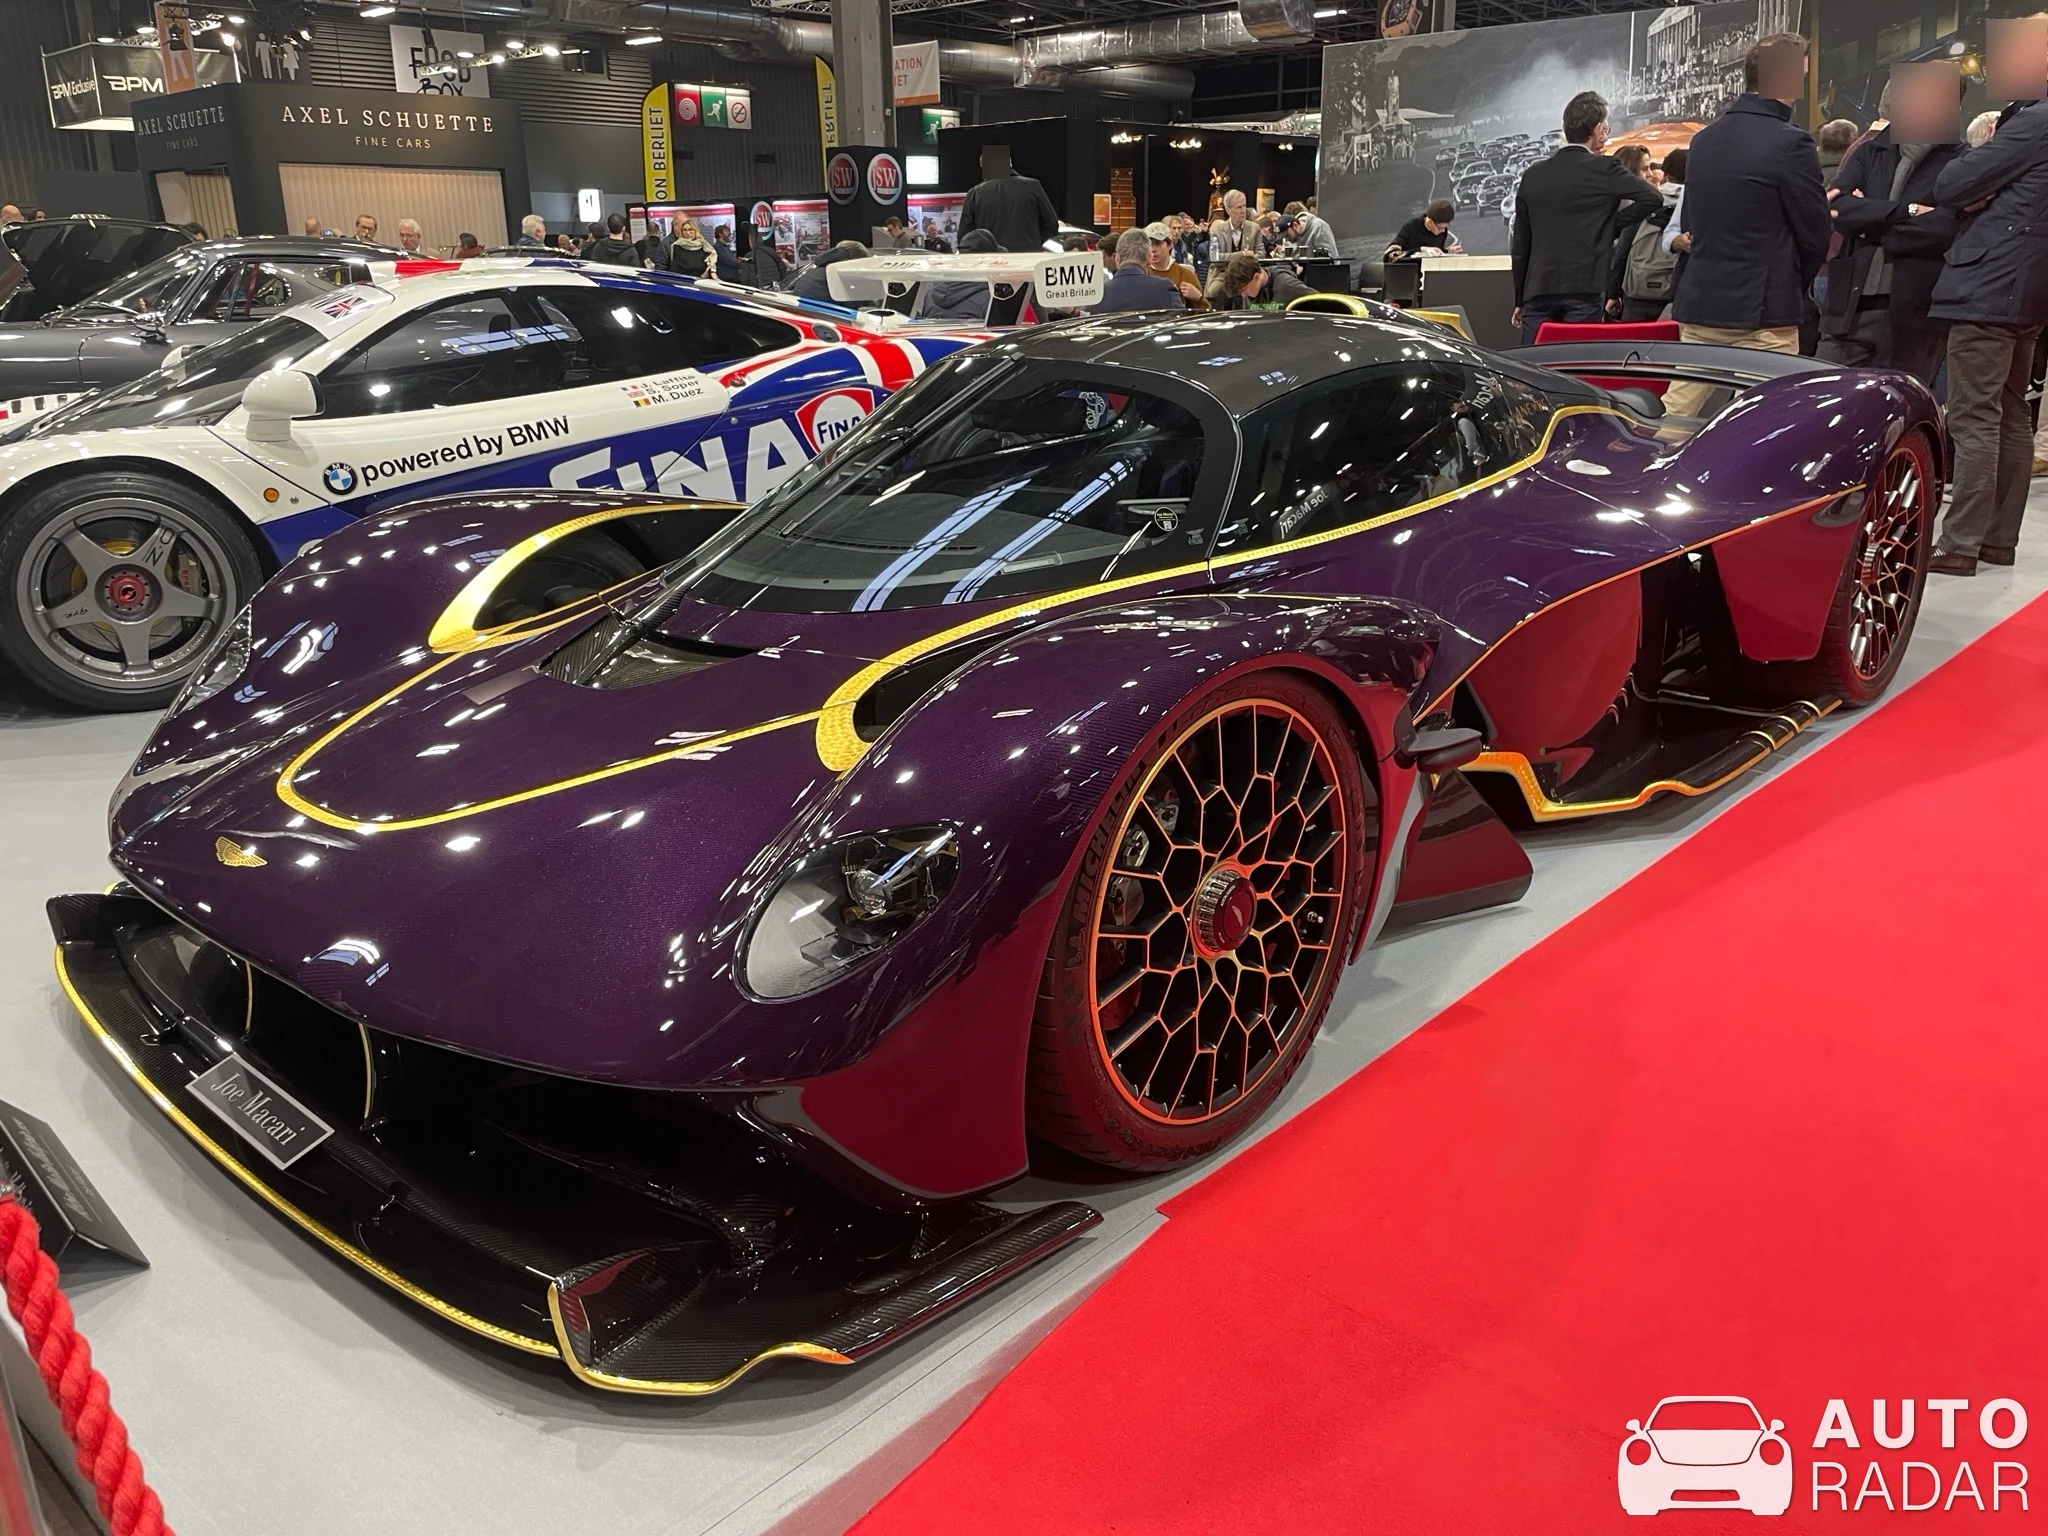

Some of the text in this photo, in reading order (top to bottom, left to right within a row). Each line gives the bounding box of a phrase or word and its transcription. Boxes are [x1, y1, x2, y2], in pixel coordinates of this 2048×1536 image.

[102, 75, 164, 93] BPM
[138, 105, 225, 136] AXEL SCHUETTE
[282, 105, 493, 133] AXEL SCHUETTE
[165, 137, 198, 150] FINE CARS
[356, 136, 431, 149] FINE CARS
[649, 107, 667, 170] BERLIET
[1045, 265, 1095, 287] BMW
[1045, 288, 1096, 299] Great Britain
[646, 380, 700, 395] S. Soper
[653, 375, 696, 385] Laffite
[652, 388, 704, 404] M. Duez
[361, 415, 570, 486] powered by BMW
[324, 462, 352, 476] BMW
[210, 1071, 306, 1146] Joe Macari
